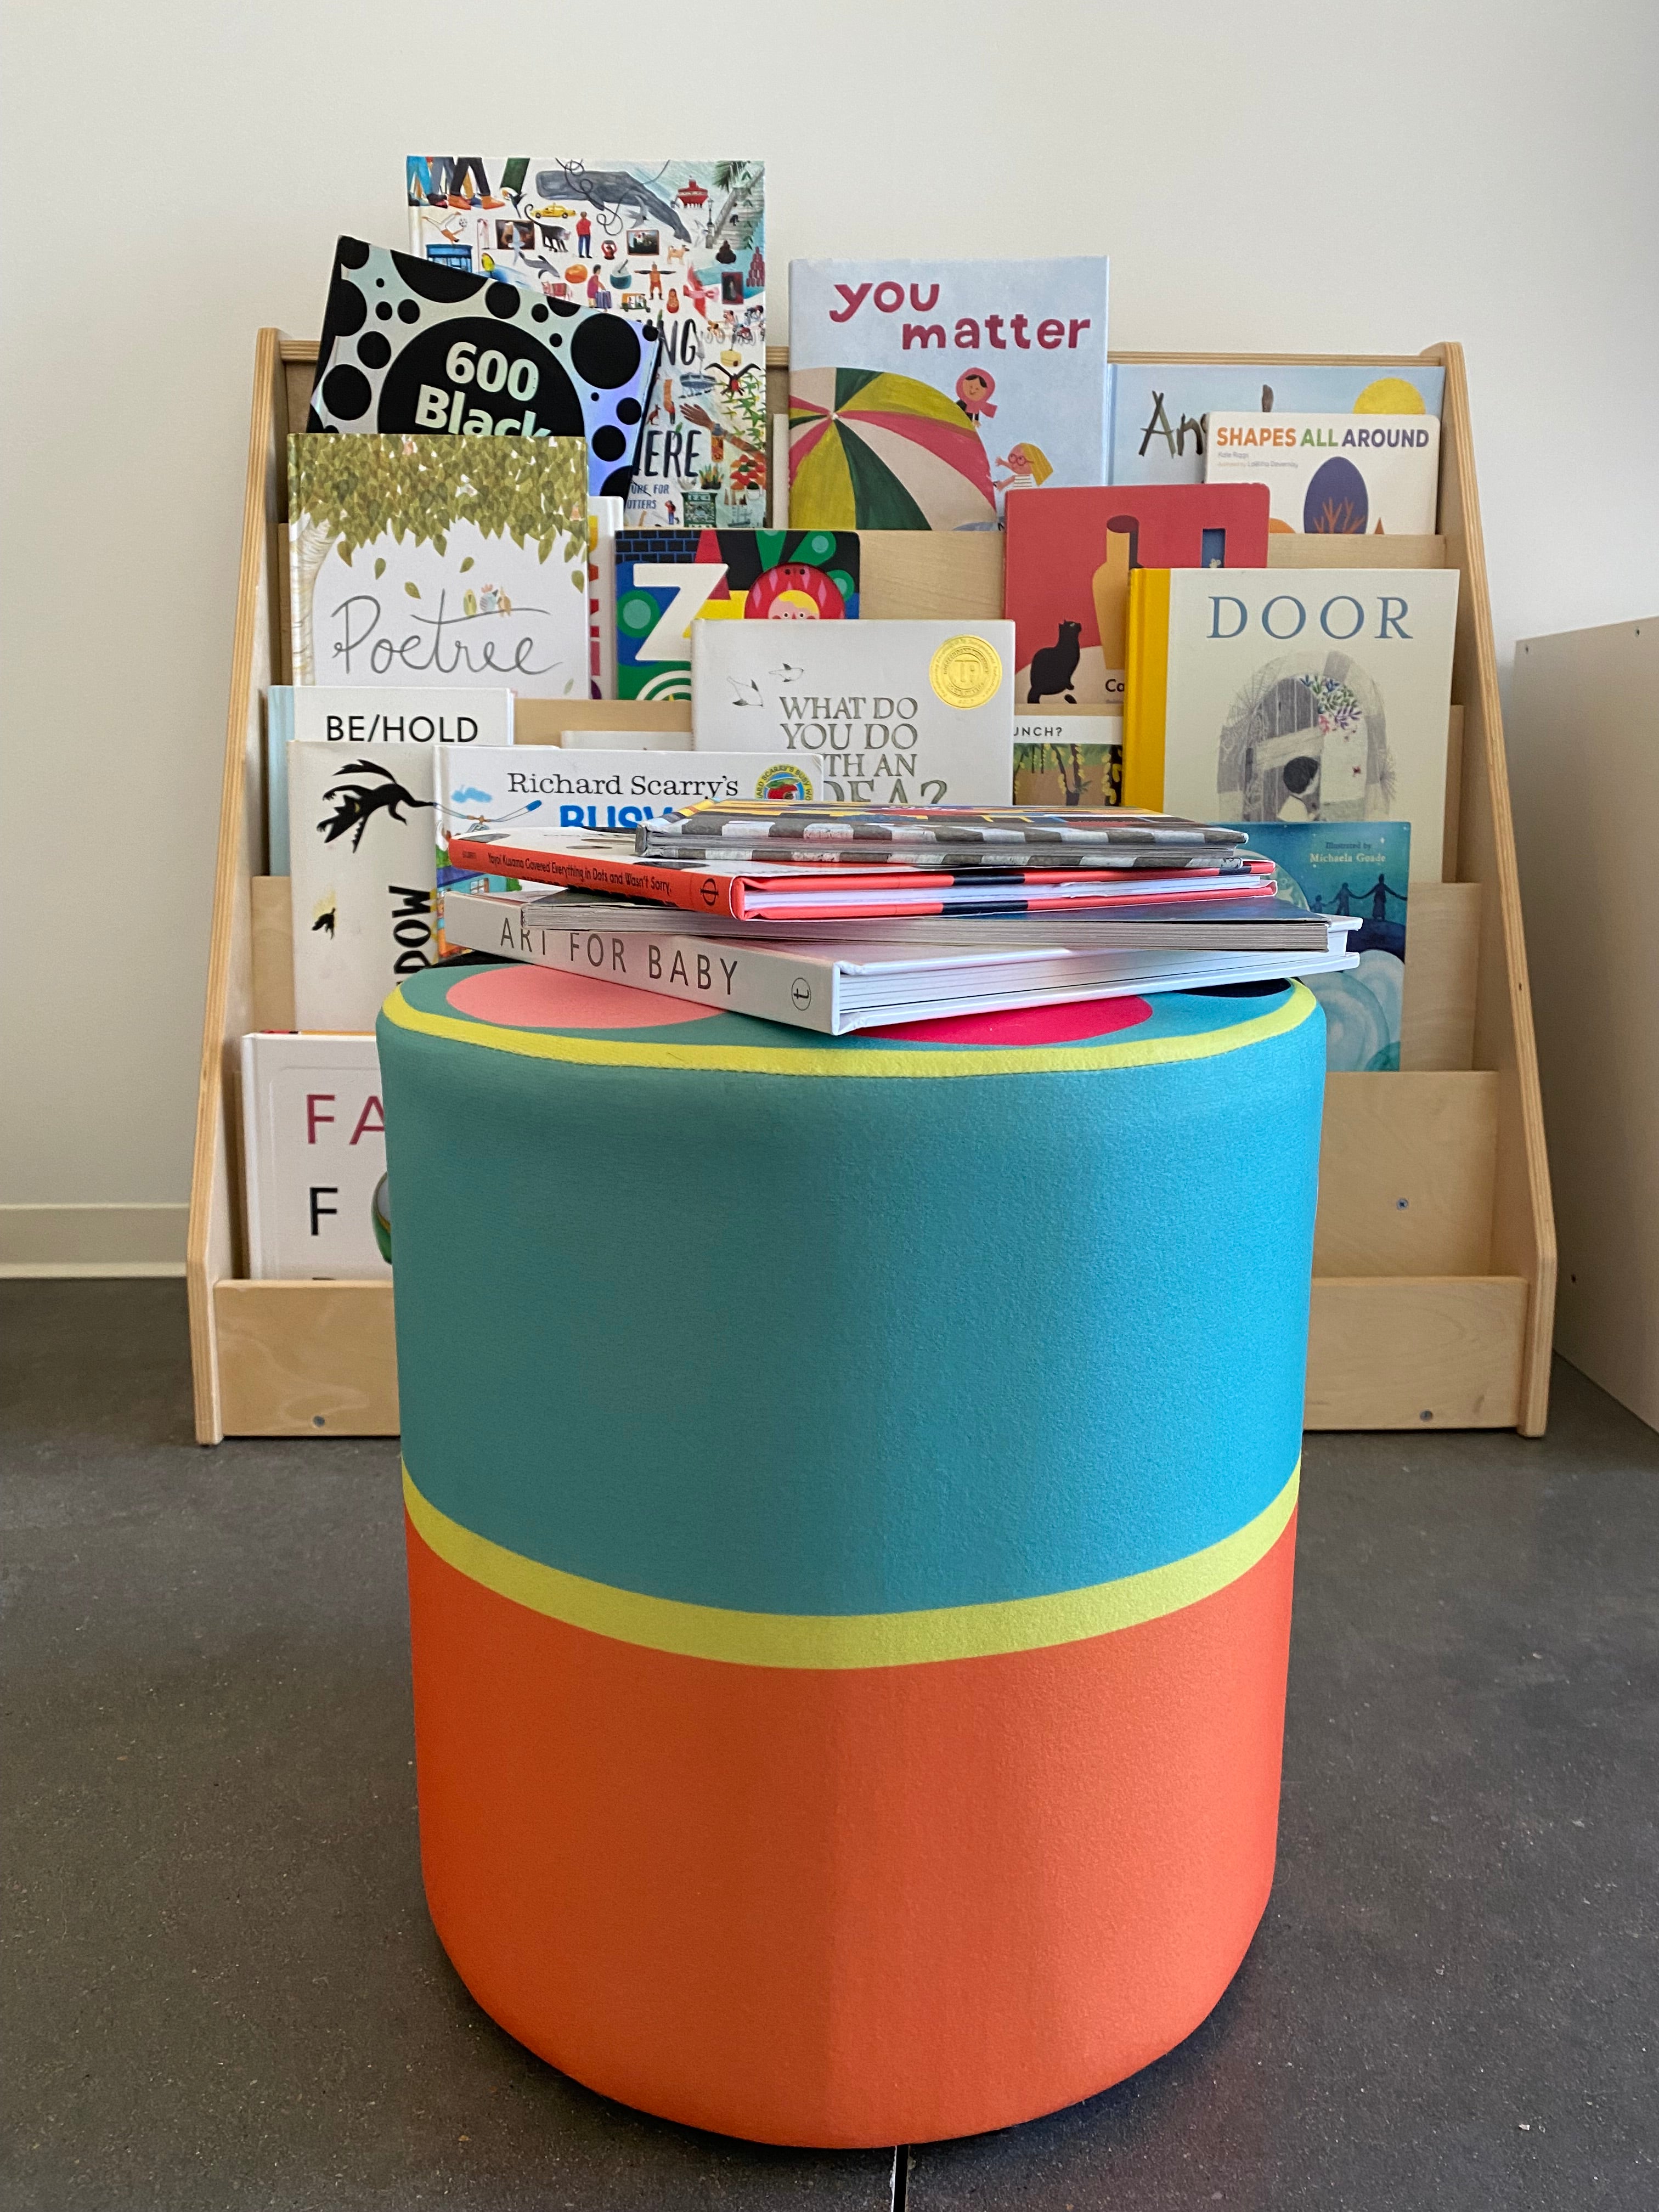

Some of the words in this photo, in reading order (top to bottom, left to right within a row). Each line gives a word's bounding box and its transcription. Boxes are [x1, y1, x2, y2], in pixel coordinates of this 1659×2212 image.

[829, 281, 940, 323] you
[901, 313, 1091, 351] matter
[445, 341, 539, 402] 600
[1216, 426, 1297, 447] SHAPES
[1300, 428, 1339, 447] ALL
[1341, 428, 1430, 448] AROUND
[653, 484, 669, 494] FOR
[331, 588, 564, 675] Poetree
[1206, 595, 1414, 640] DOOR
[778, 696, 867, 720] WHAT
[873, 697, 918, 720] DO
[327, 714, 479, 743] BE/HOLD
[780, 723, 853, 751] YOU
[864, 723, 918, 751] DO
[873, 753, 918, 777] AN
[507, 772, 624, 795] Richard
[630, 775, 739, 799] Scarry's
[502, 855, 524, 869] Kusama
[525, 858, 550, 873] Covered
[551, 861, 584, 882] Everything
[585, 867, 591, 879] in
[592, 867, 608, 881] Dots
[610, 873, 623, 885] and
[625, 872, 649, 889] Wasn't
[1309, 852, 1353, 863] Michaela
[388, 885, 432, 986] DOW
[569, 932, 627, 973] FOR
[648, 944, 738, 995] BABY
